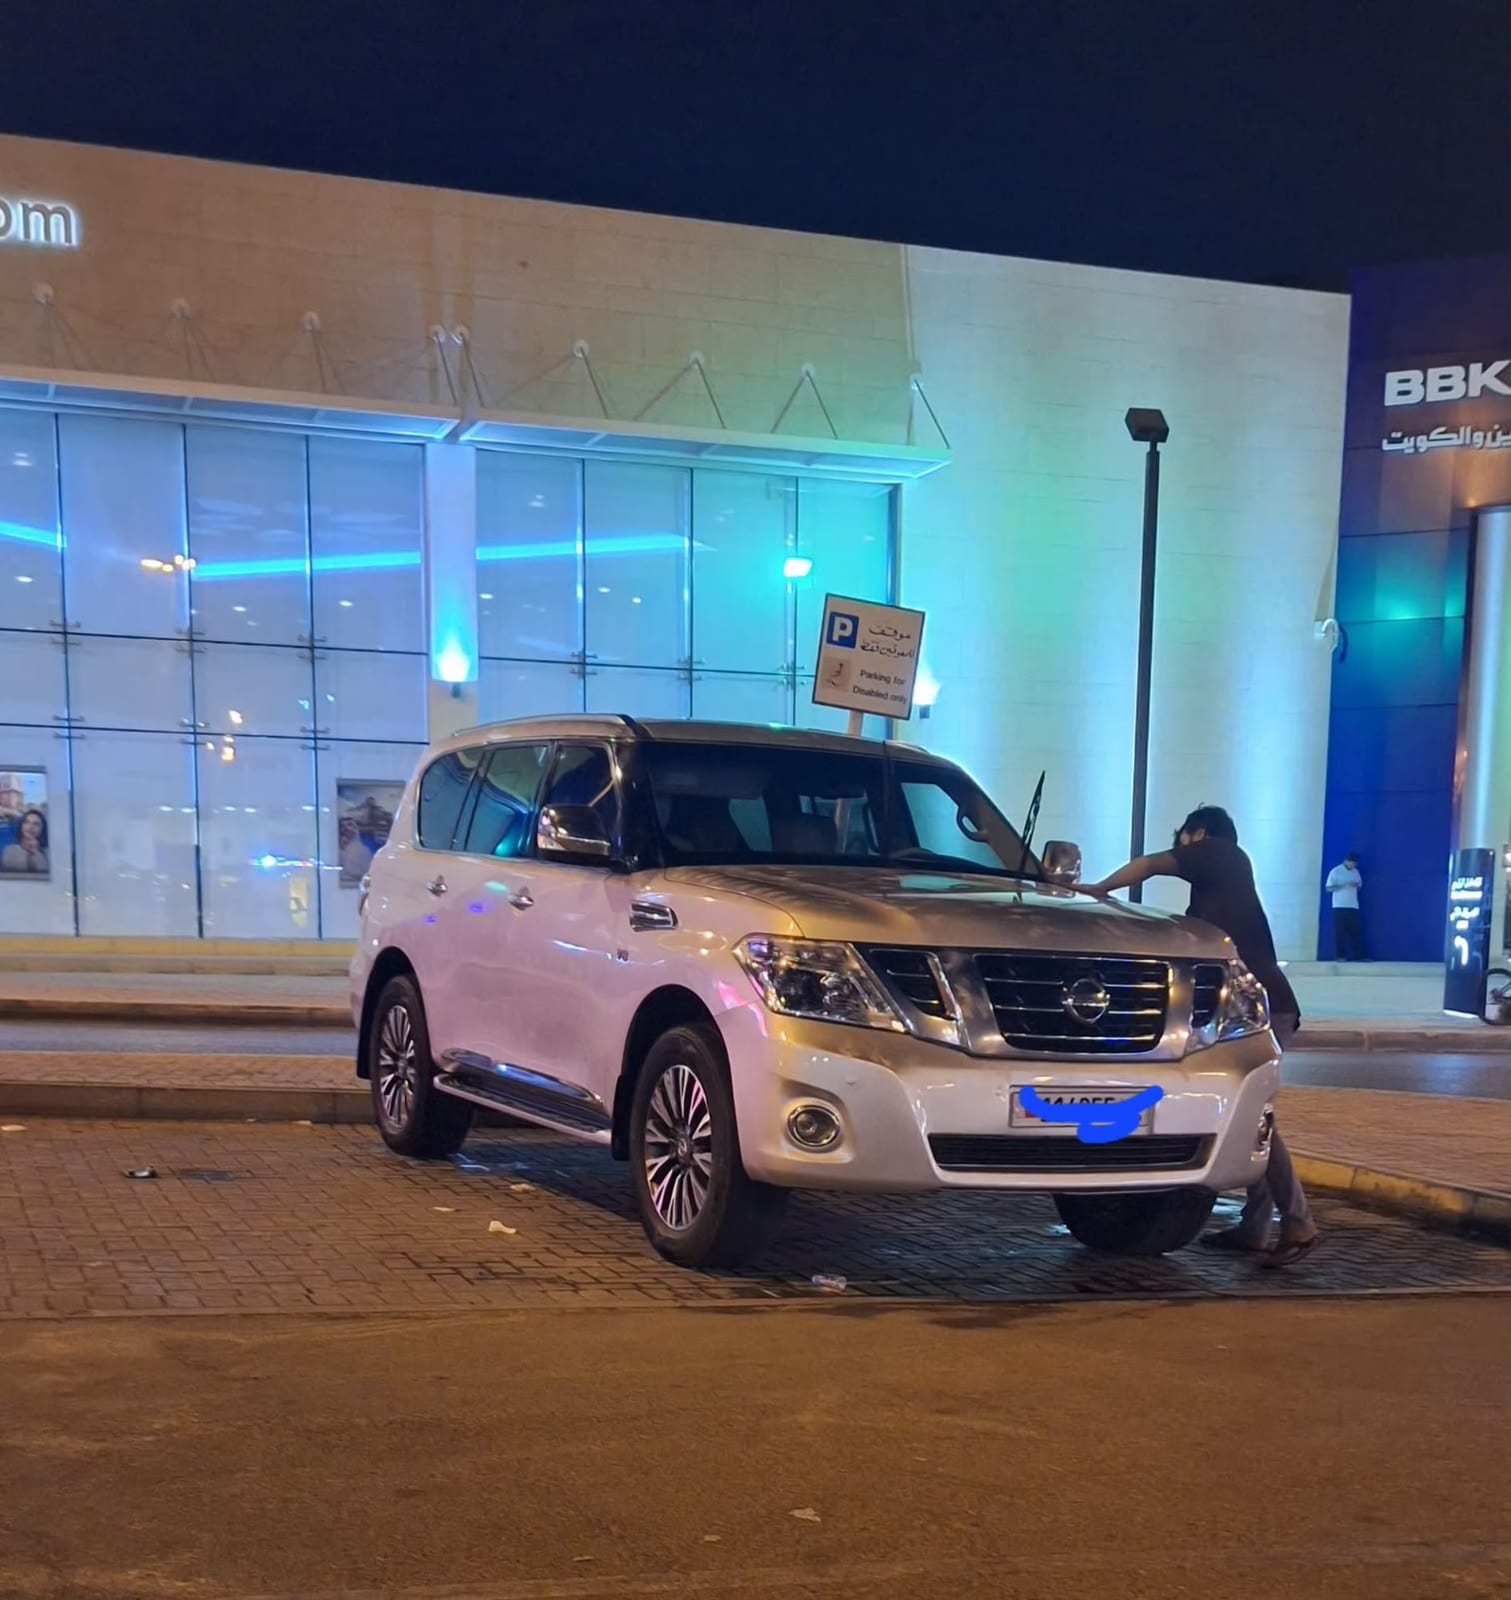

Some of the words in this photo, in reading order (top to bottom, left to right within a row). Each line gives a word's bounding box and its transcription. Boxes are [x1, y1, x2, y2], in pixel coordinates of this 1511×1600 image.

[1384, 360, 1511, 406] BBK
[832, 616, 853, 642] P
[868, 624, 911, 642] موقف
[860, 669, 891, 684] Parking
[893, 676, 906, 685] for
[852, 685, 889, 700] Disabled
